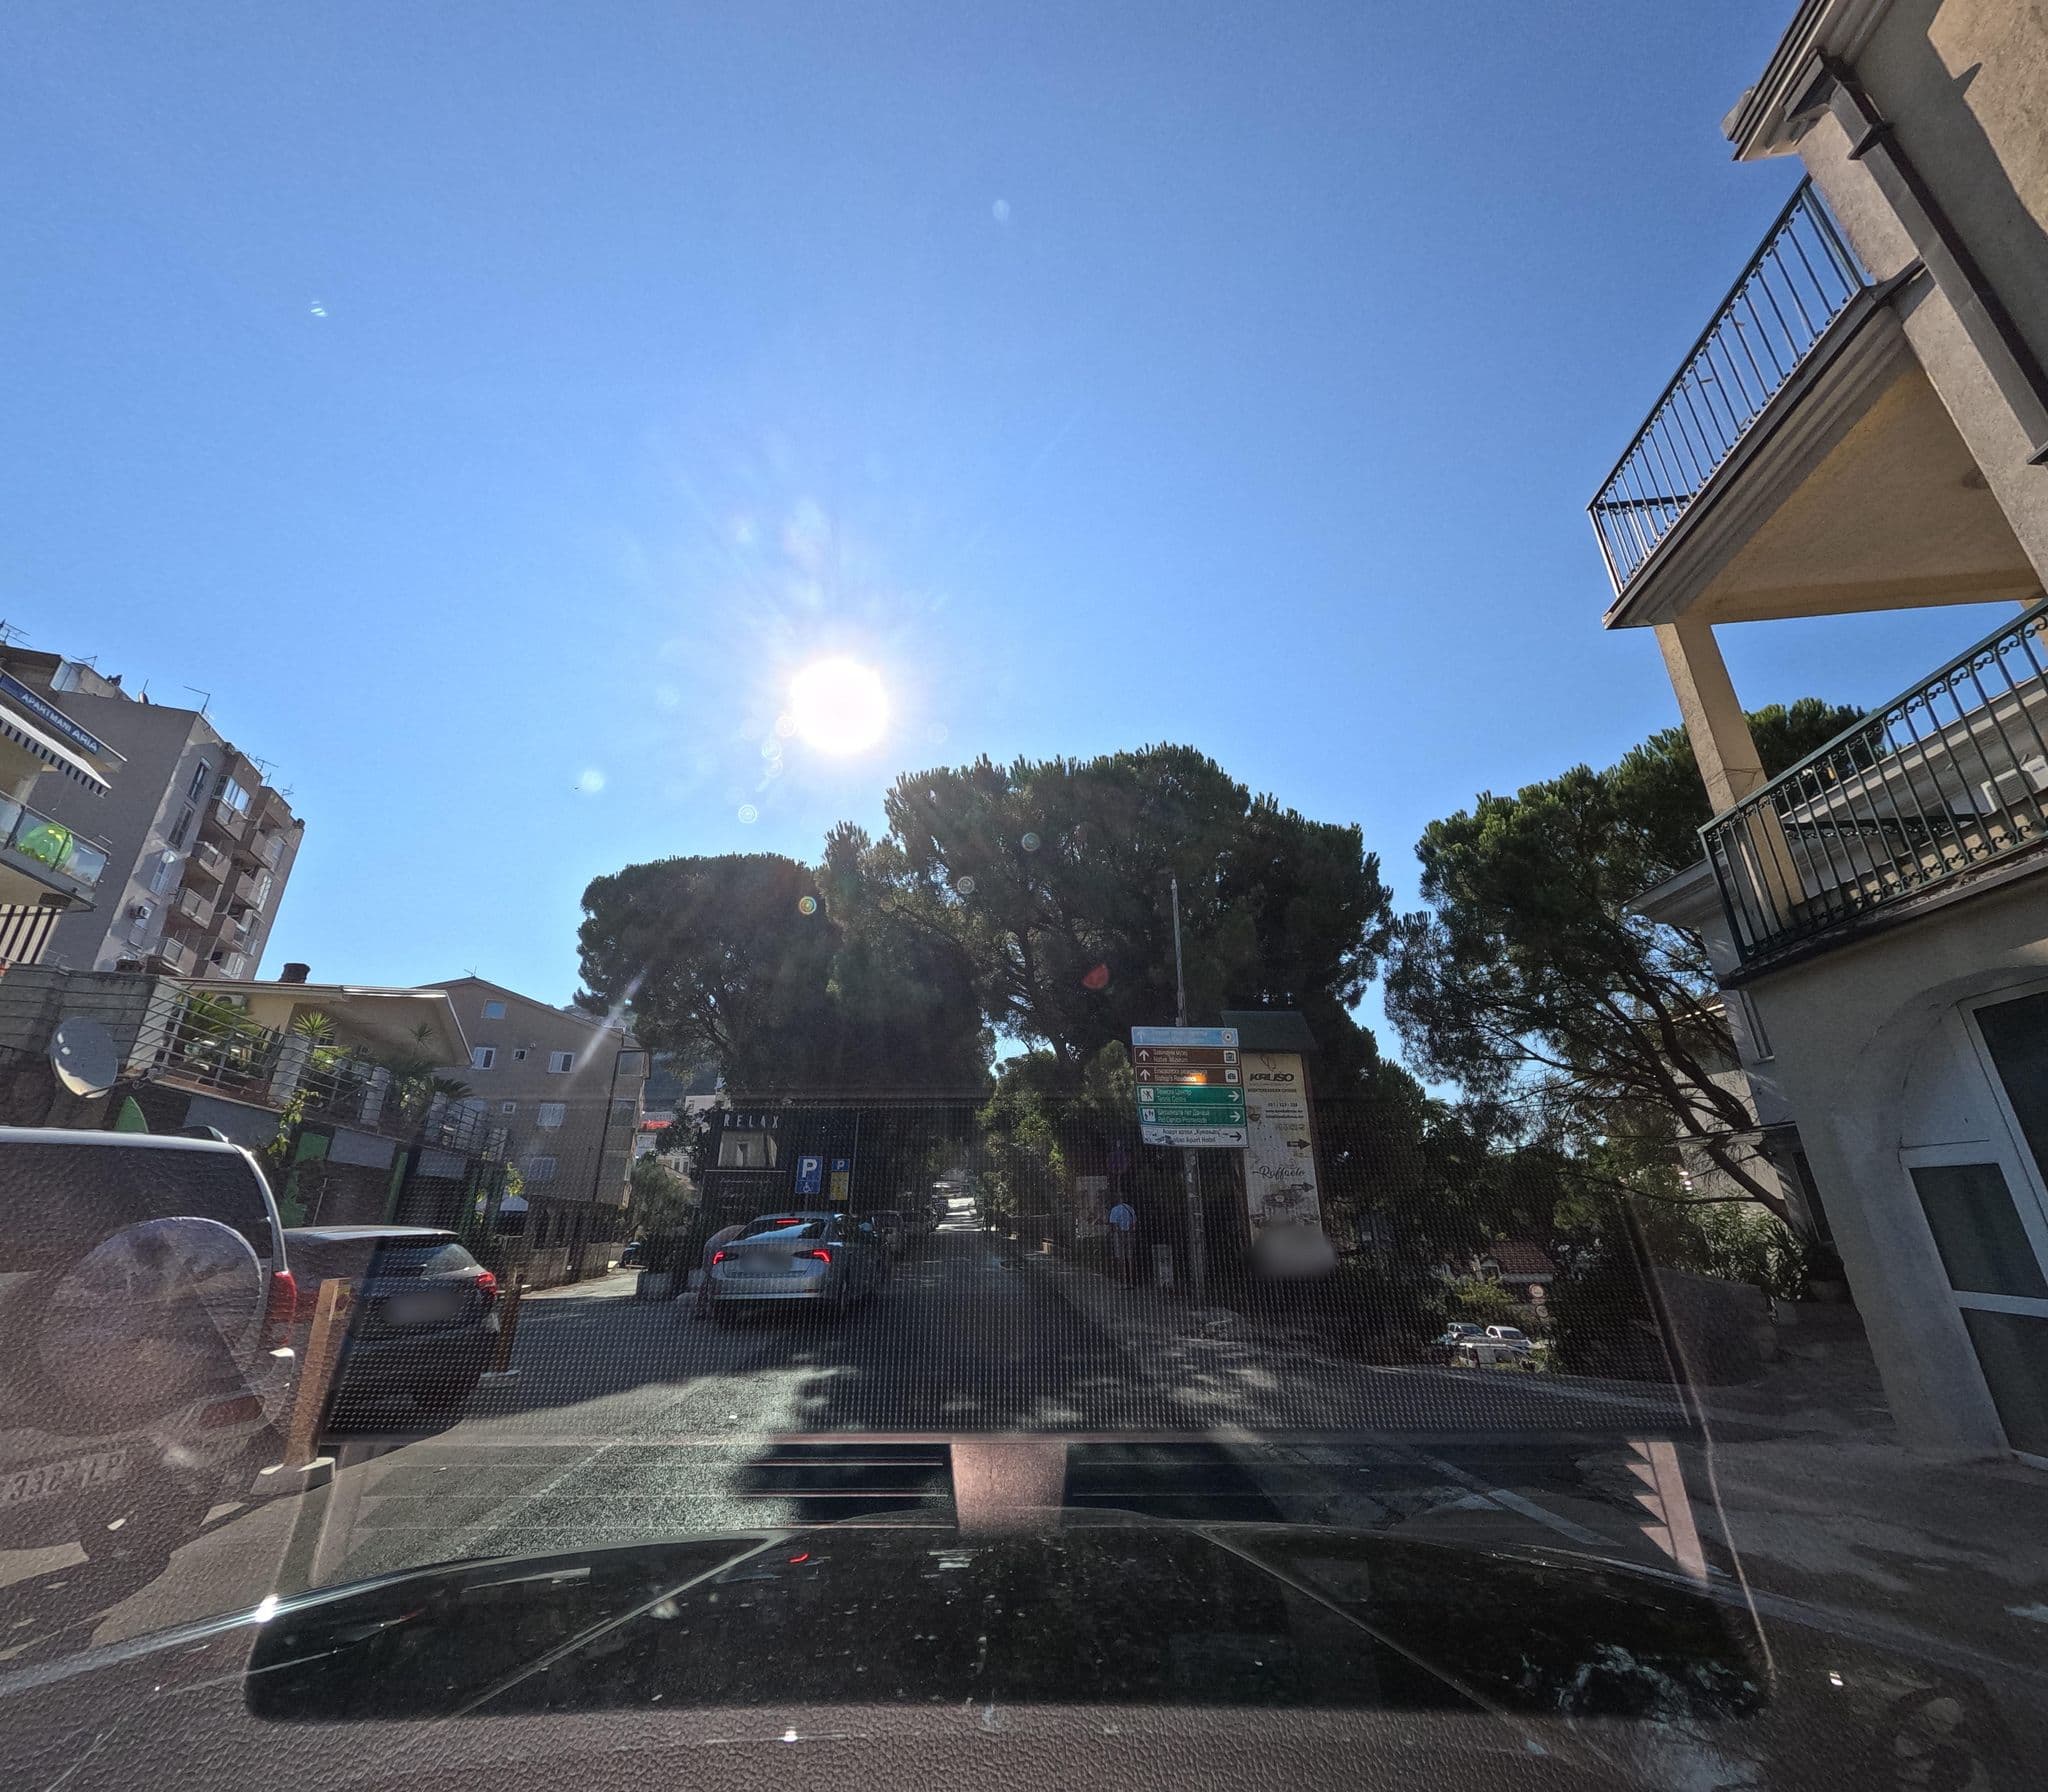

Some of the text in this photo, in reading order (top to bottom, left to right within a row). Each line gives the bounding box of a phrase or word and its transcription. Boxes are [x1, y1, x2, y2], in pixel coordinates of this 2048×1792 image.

[21, 693, 98, 752] APARTMANI ARIA
[723, 1113, 779, 1129] RELAX
[802, 1158, 818, 1178] P
